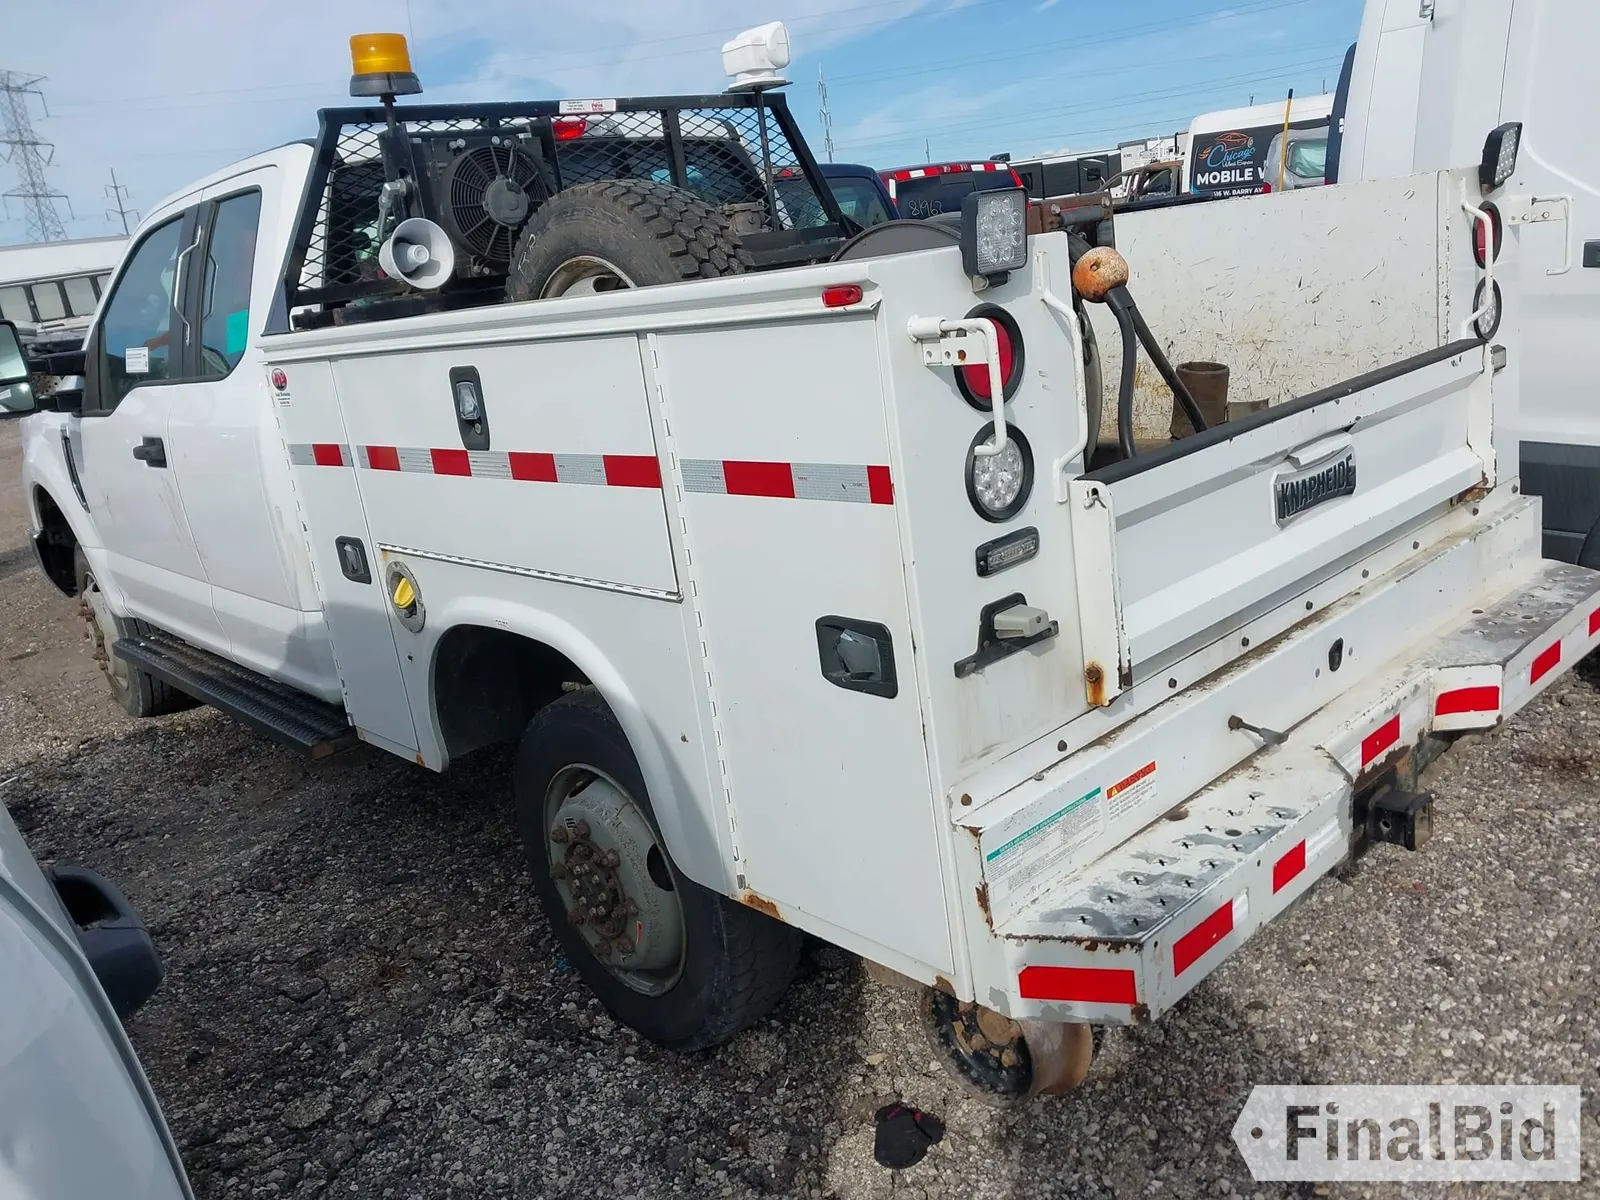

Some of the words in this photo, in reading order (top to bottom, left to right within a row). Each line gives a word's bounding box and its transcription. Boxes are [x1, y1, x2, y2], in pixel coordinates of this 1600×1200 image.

[1207, 145, 1256, 167] Chicago
[1197, 168, 1253, 185] MOBILE
[1232, 187, 1253, 196] BARRY
[1279, 453, 1354, 519] KNAPHEIDE
